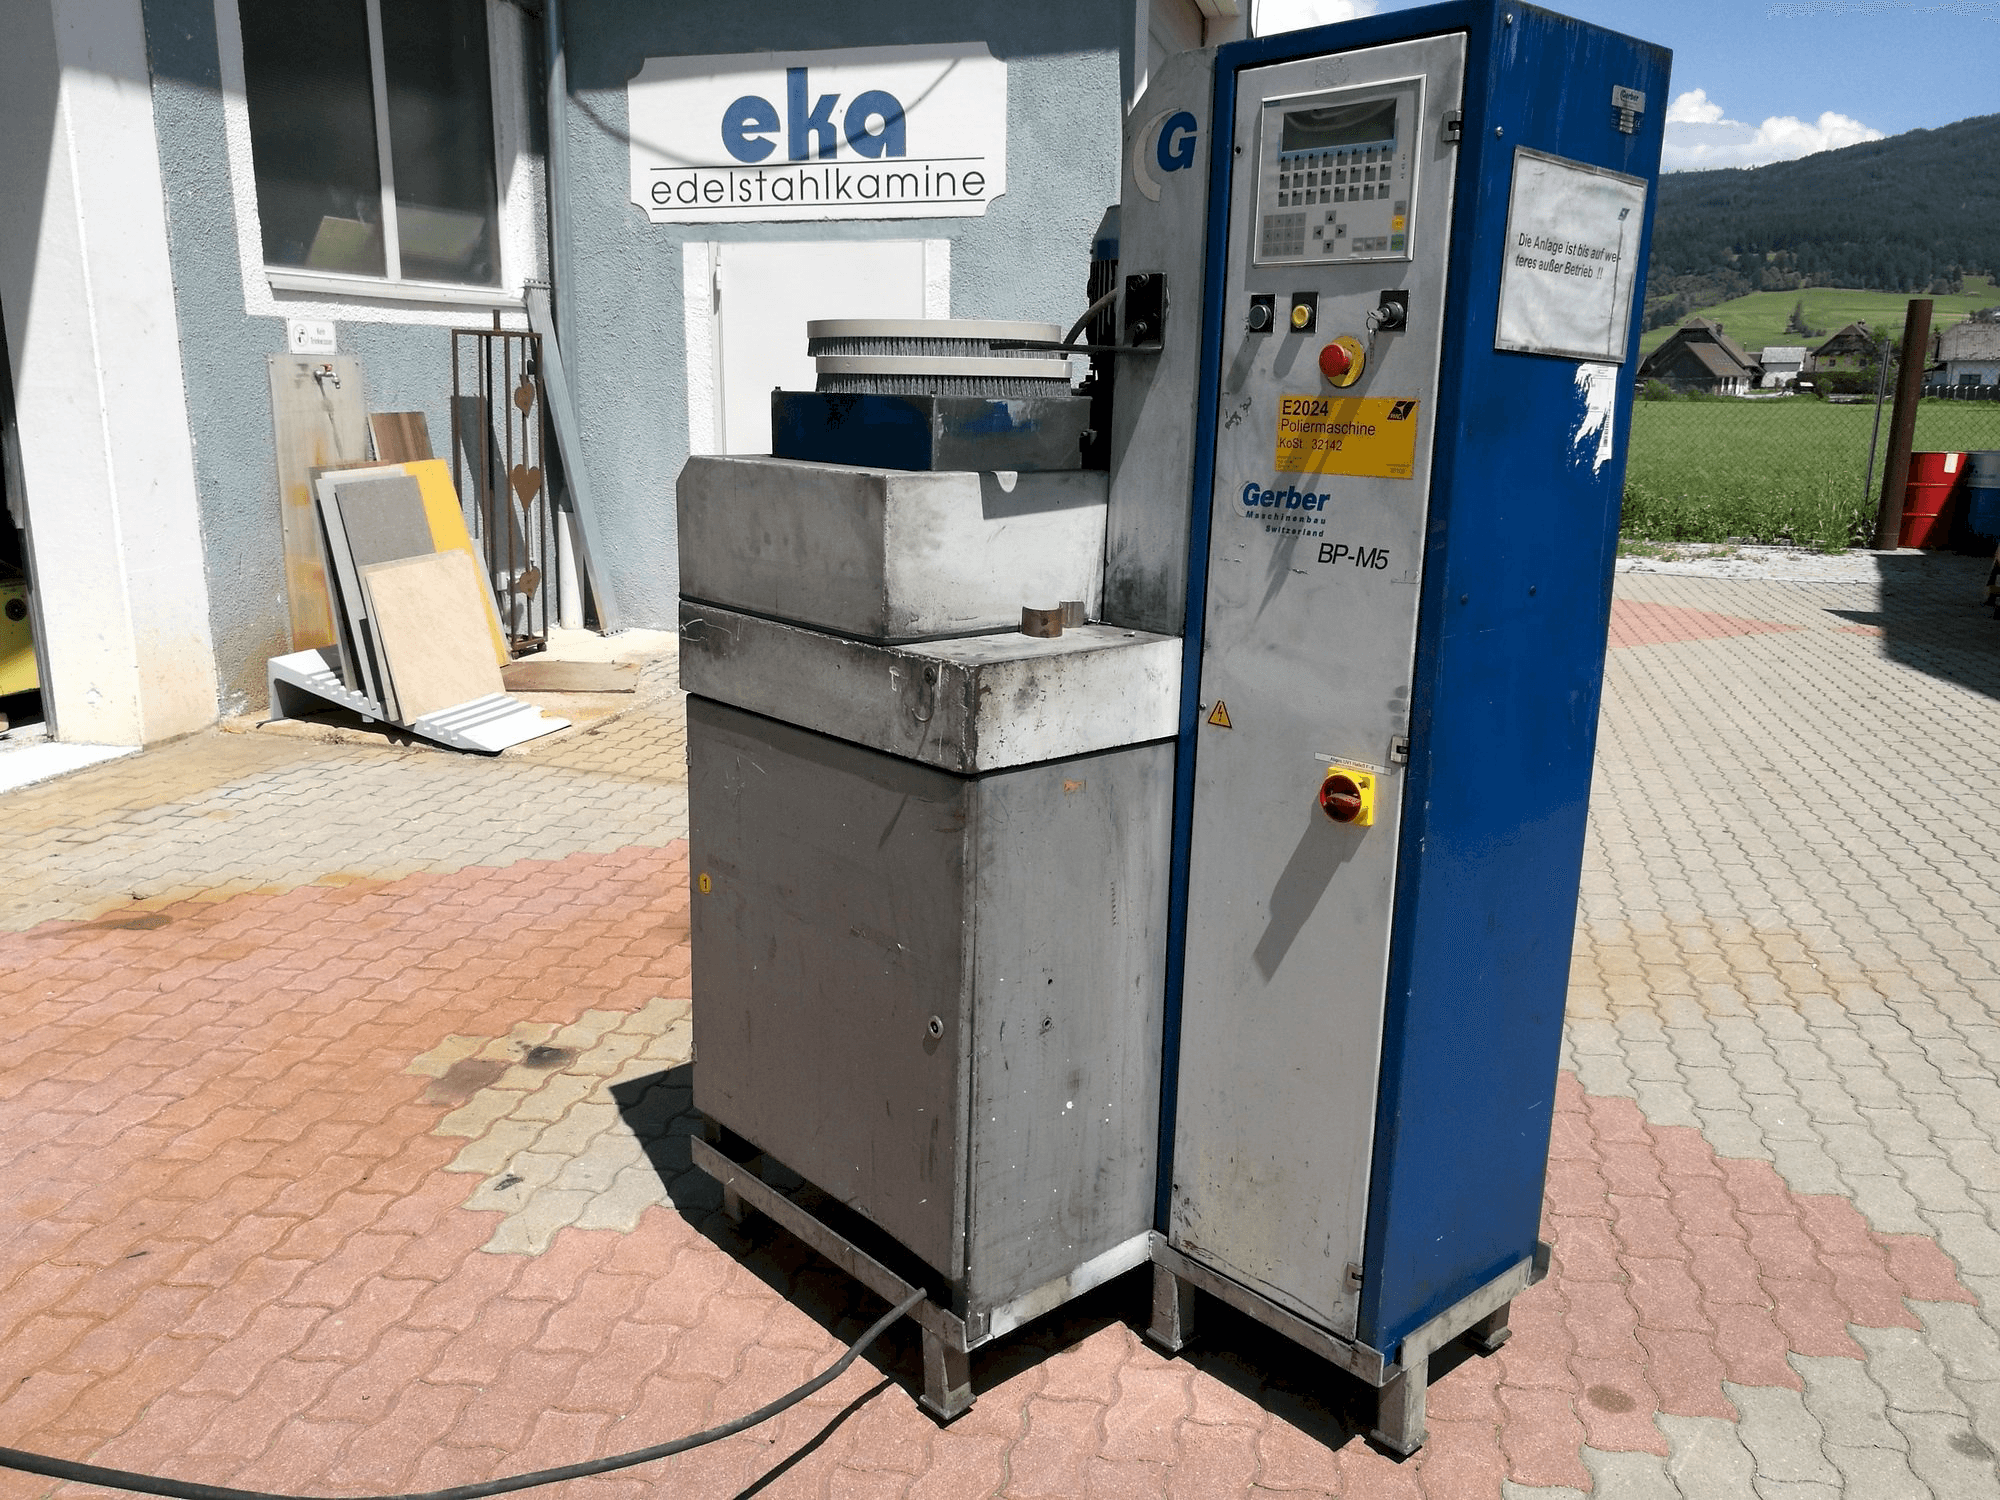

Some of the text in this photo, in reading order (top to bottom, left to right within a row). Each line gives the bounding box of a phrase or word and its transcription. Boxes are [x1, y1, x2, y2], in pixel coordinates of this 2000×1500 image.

[721, 67, 906, 163] eka
[651, 165, 986, 204] edelstahlkamine
[1518, 233, 1532, 248] Die
[1533, 236, 1564, 255] Anlage
[1565, 242, 1576, 256] ist
[1577, 244, 1589, 258] bis
[1590, 248, 1605, 260] auf
[1515, 254, 1604, 279] teres außer Betrieb !!
[1282, 400, 1329, 416] E2024
[1281, 418, 1376, 436] Poliermaschine
[1311, 439, 1343, 451] 32142
[1243, 482, 1331, 511] Gerber
[1246, 511, 1326, 524] Maschinenbau
[1265, 525, 1324, 537] Switzerland
[1318, 543, 1390, 569] BP-M5
